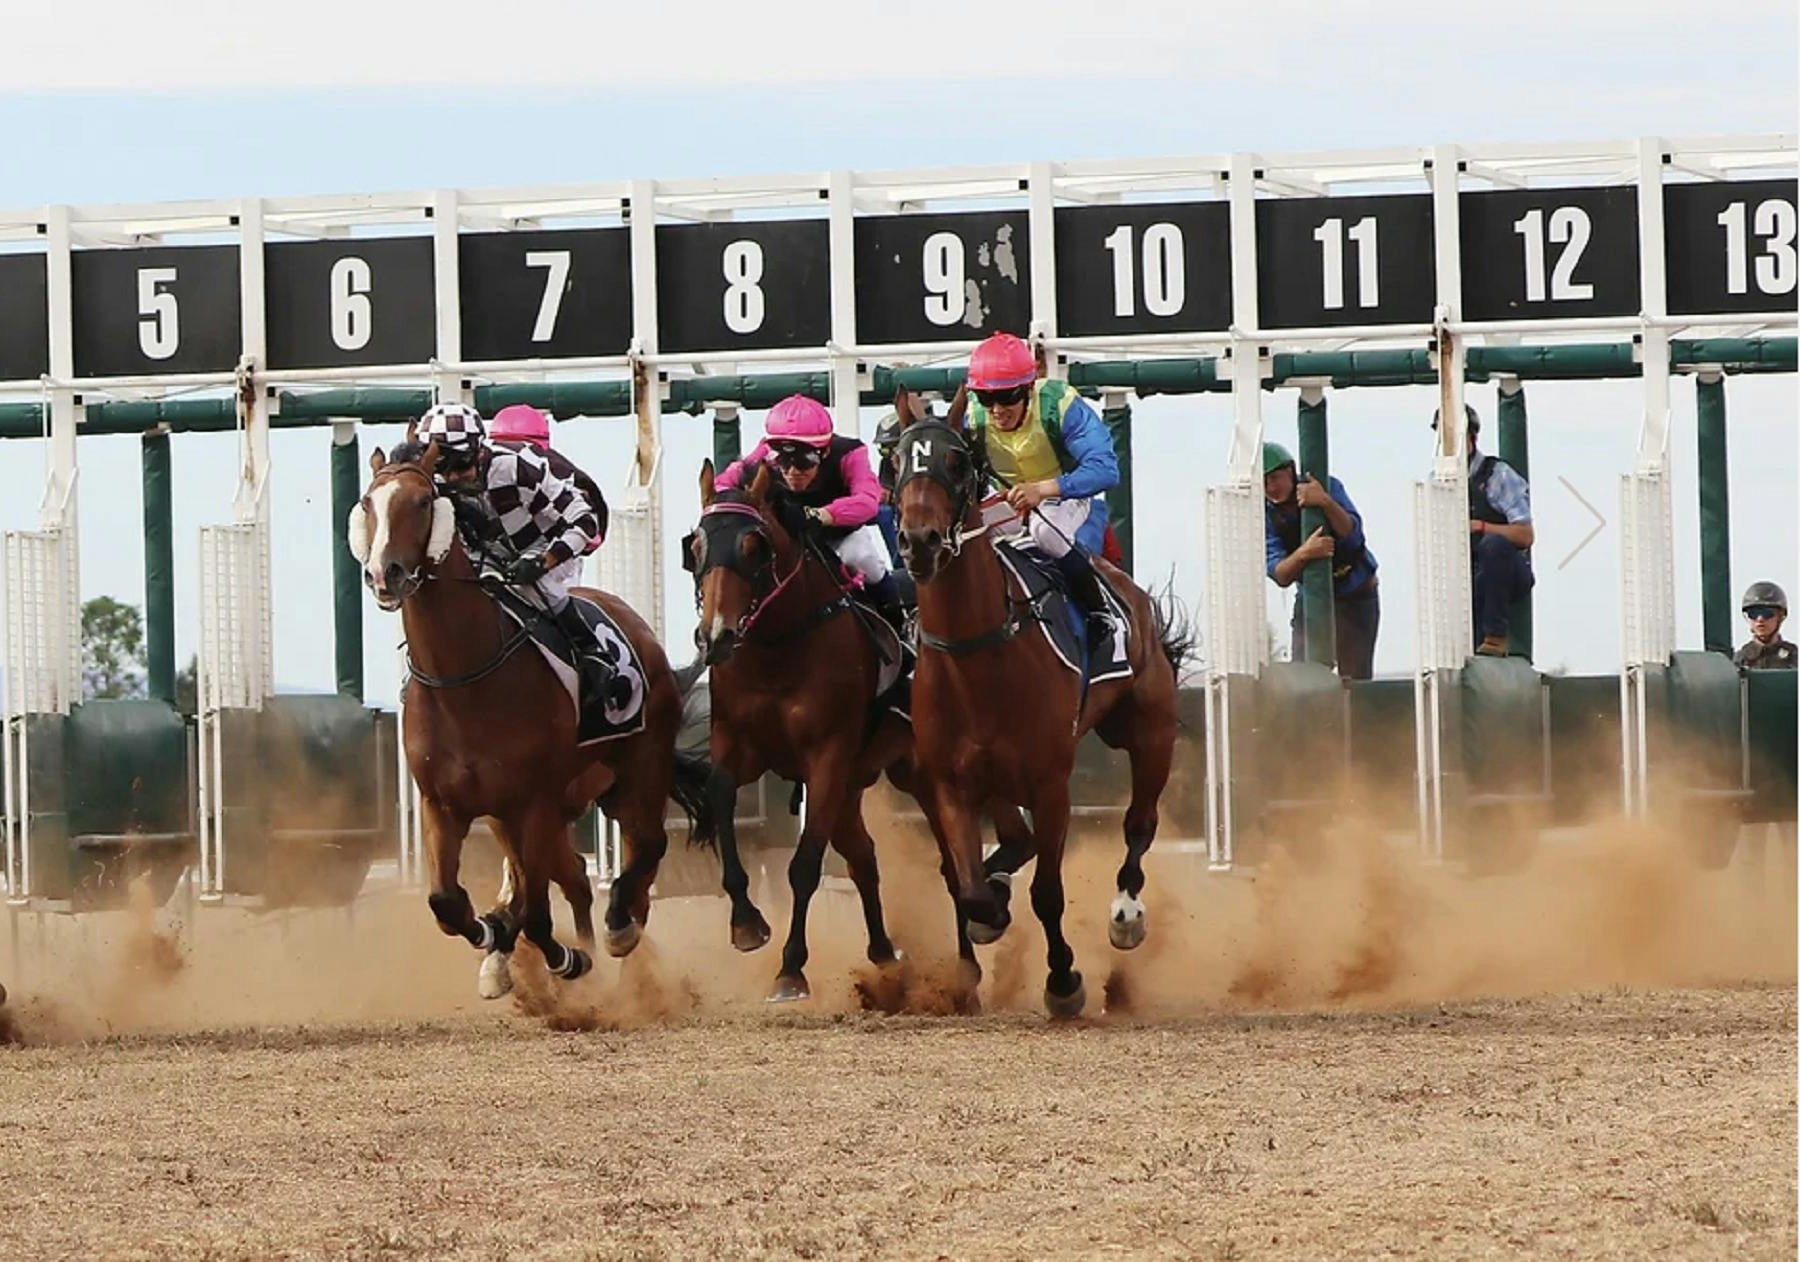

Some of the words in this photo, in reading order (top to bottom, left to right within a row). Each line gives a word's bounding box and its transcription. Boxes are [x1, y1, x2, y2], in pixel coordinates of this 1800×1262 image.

[724, 240, 765, 332] 8
[923, 233, 964, 325] 9
[1106, 224, 1185, 316] 10
[1315, 217, 1379, 308] 11
[1515, 206, 1594, 301] 12
[1718, 199, 1797, 294] 13
[138, 268, 178, 359] 5
[331, 258, 371, 350] 6
[526, 250, 570, 341] 7
